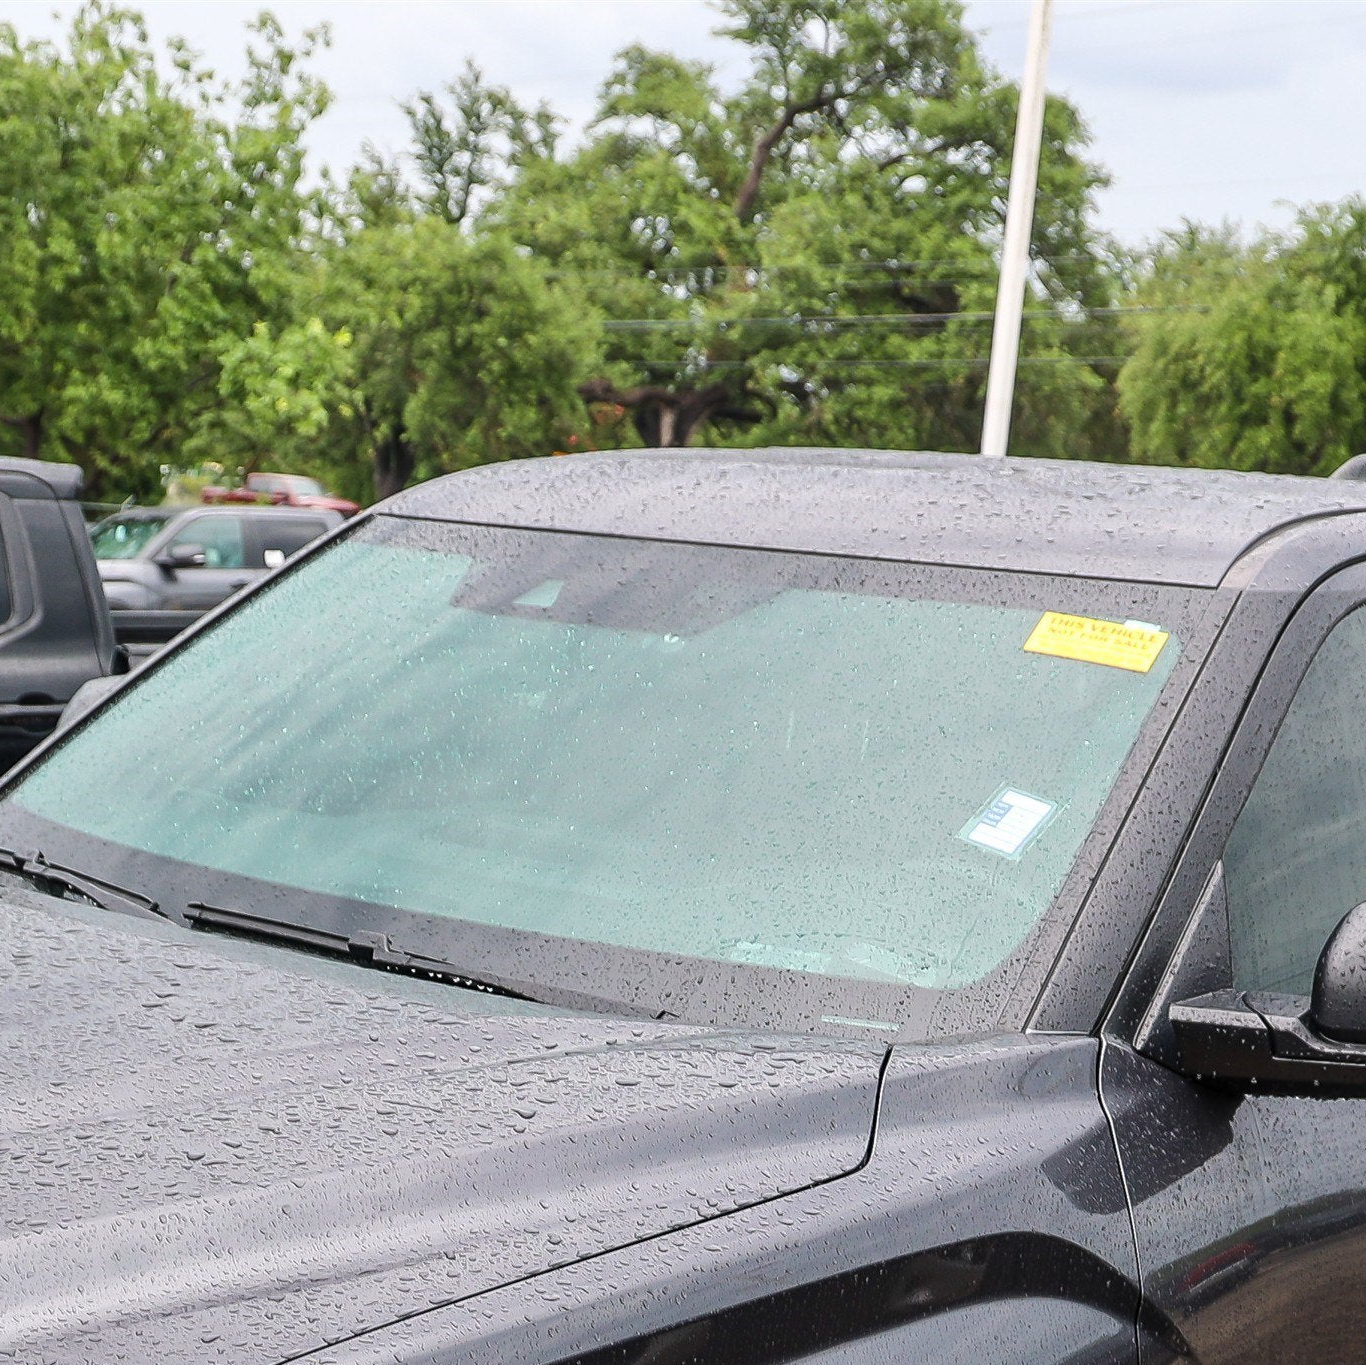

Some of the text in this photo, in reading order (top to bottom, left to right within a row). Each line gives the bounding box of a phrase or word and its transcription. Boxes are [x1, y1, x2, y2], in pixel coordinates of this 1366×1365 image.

[1048, 626, 1074, 637] NOT
[1114, 638, 1148, 650] SALE
[1050, 616, 1157, 643] THIS VEHICLE
